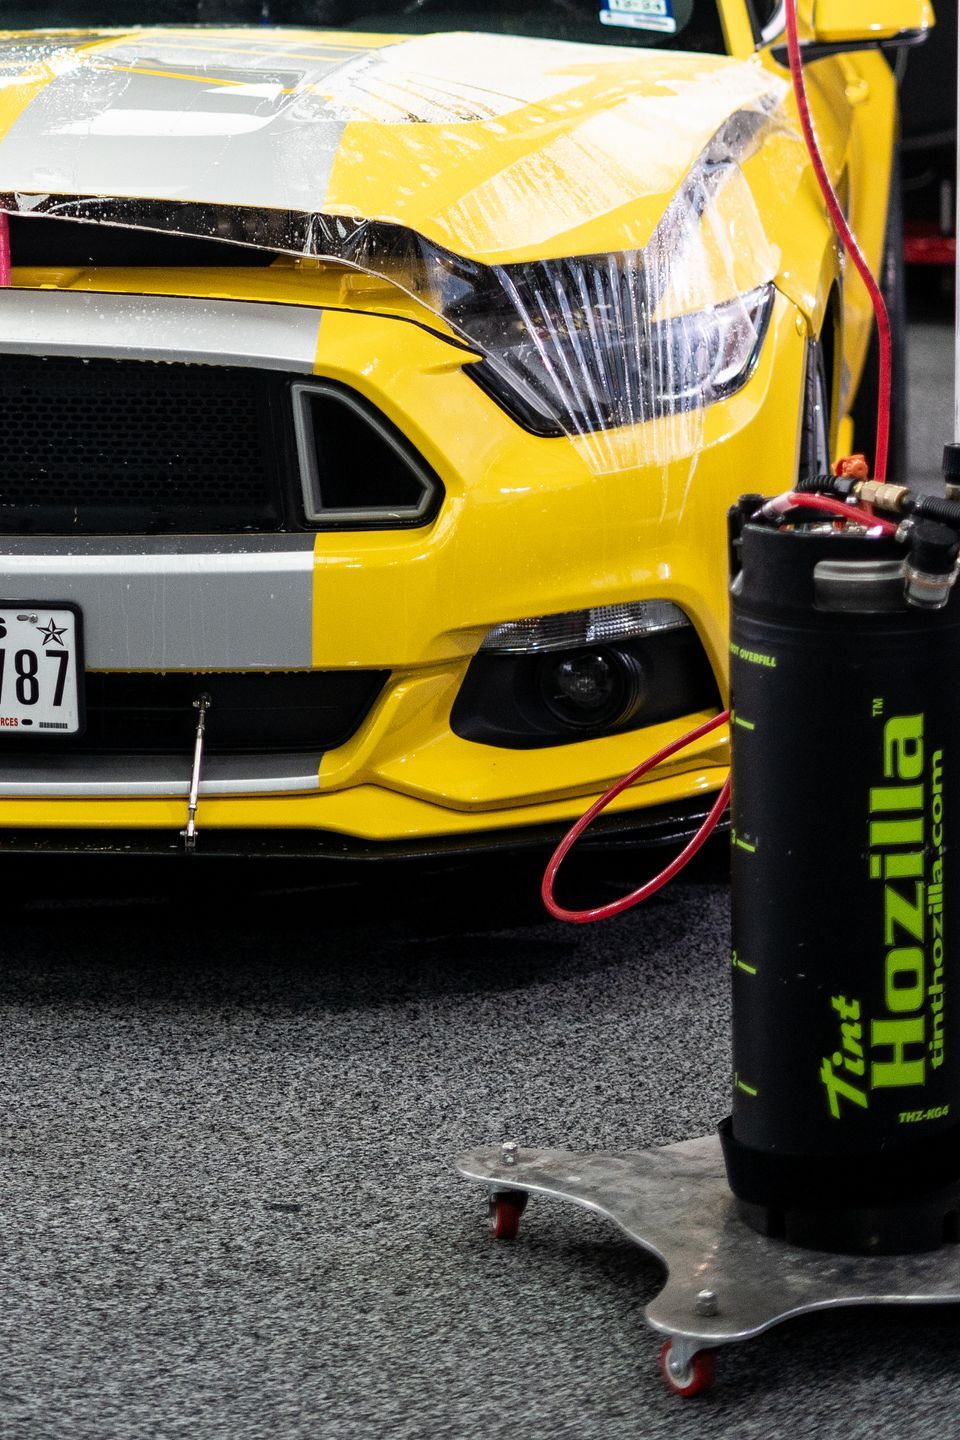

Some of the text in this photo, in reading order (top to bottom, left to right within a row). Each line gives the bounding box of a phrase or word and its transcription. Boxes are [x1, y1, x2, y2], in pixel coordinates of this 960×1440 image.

[739, 649, 777, 667] OVERFILL
[872, 697, 884, 718] TM
[868, 712, 925, 1090] Hozilla
[927, 749, 945, 1070] tinthozilla.com
[819, 995, 869, 1120] Tint
